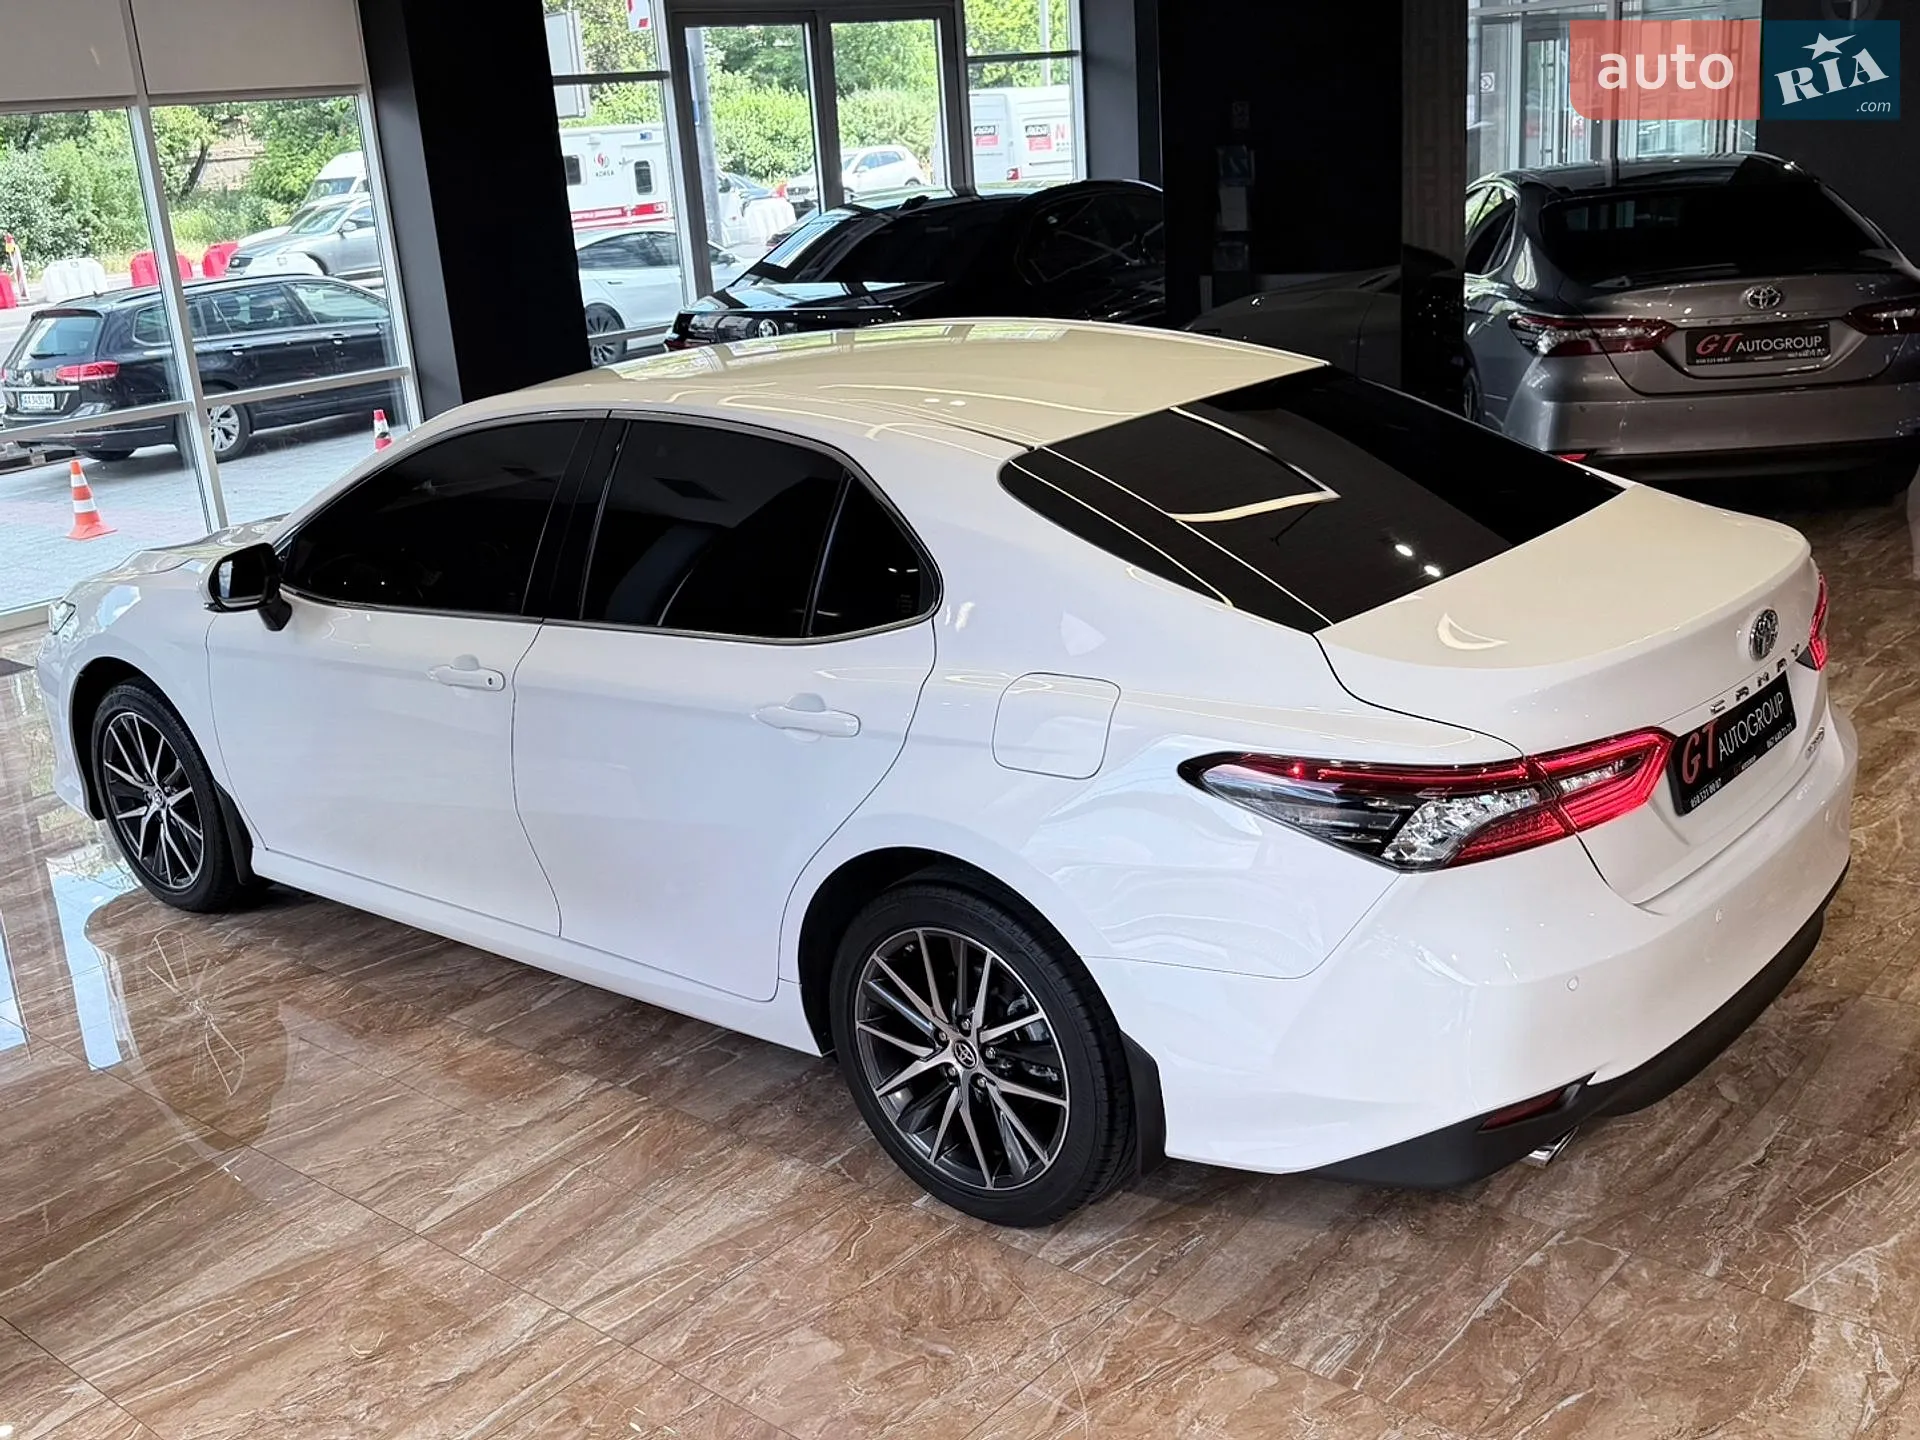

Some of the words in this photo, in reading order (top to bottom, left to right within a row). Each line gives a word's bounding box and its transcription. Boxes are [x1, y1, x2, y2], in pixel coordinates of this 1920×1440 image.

[1696, 332, 1744, 356] GT
[1736, 336, 1823, 354] AUTOGROUP
[1681, 718, 1719, 784] GT
[1718, 691, 1785, 762] AUTOGROUP
